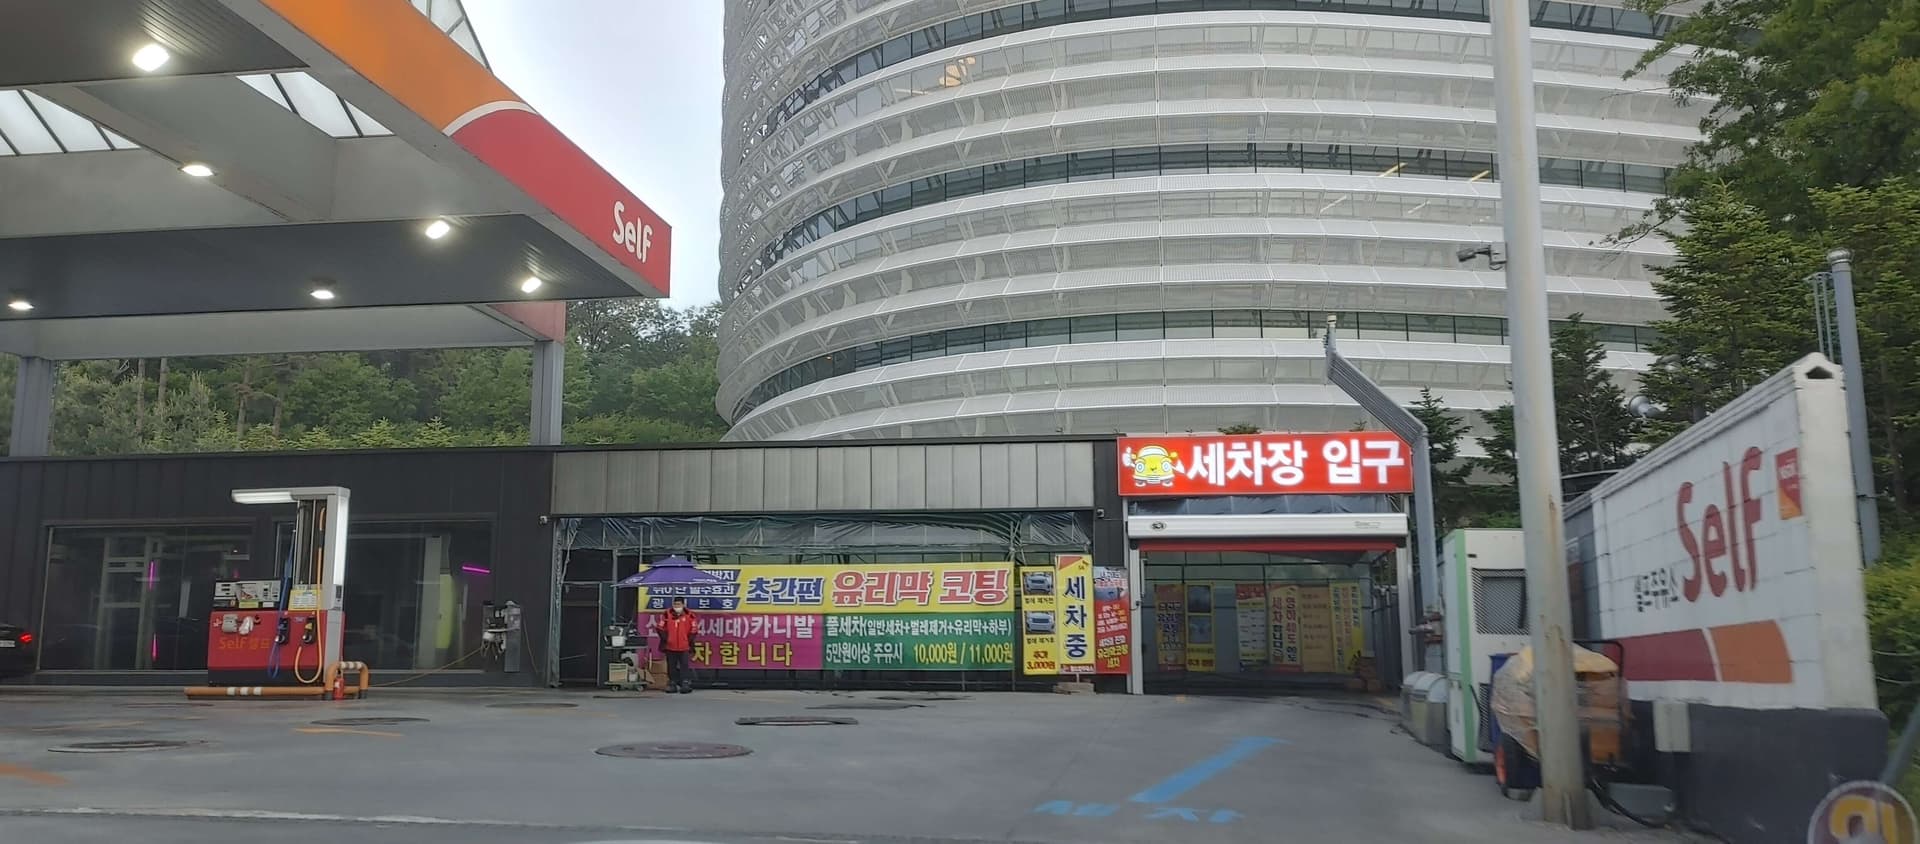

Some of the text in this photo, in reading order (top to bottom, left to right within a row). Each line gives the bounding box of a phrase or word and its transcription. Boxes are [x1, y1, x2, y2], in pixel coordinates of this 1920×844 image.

[612, 200, 653, 263] Self
[1187, 439, 1404, 486] 세차장 입구
[1676, 446, 1763, 602] Self
[746, 569, 1009, 606] 초간편 유리막 코팅
[219, 637, 247, 649] Self
[826, 643, 871, 664] 5만원이상
[874, 643, 903, 664] 주유시
[914, 642, 957, 665] 10,000원
[969, 641, 1013, 665] 11,000원
